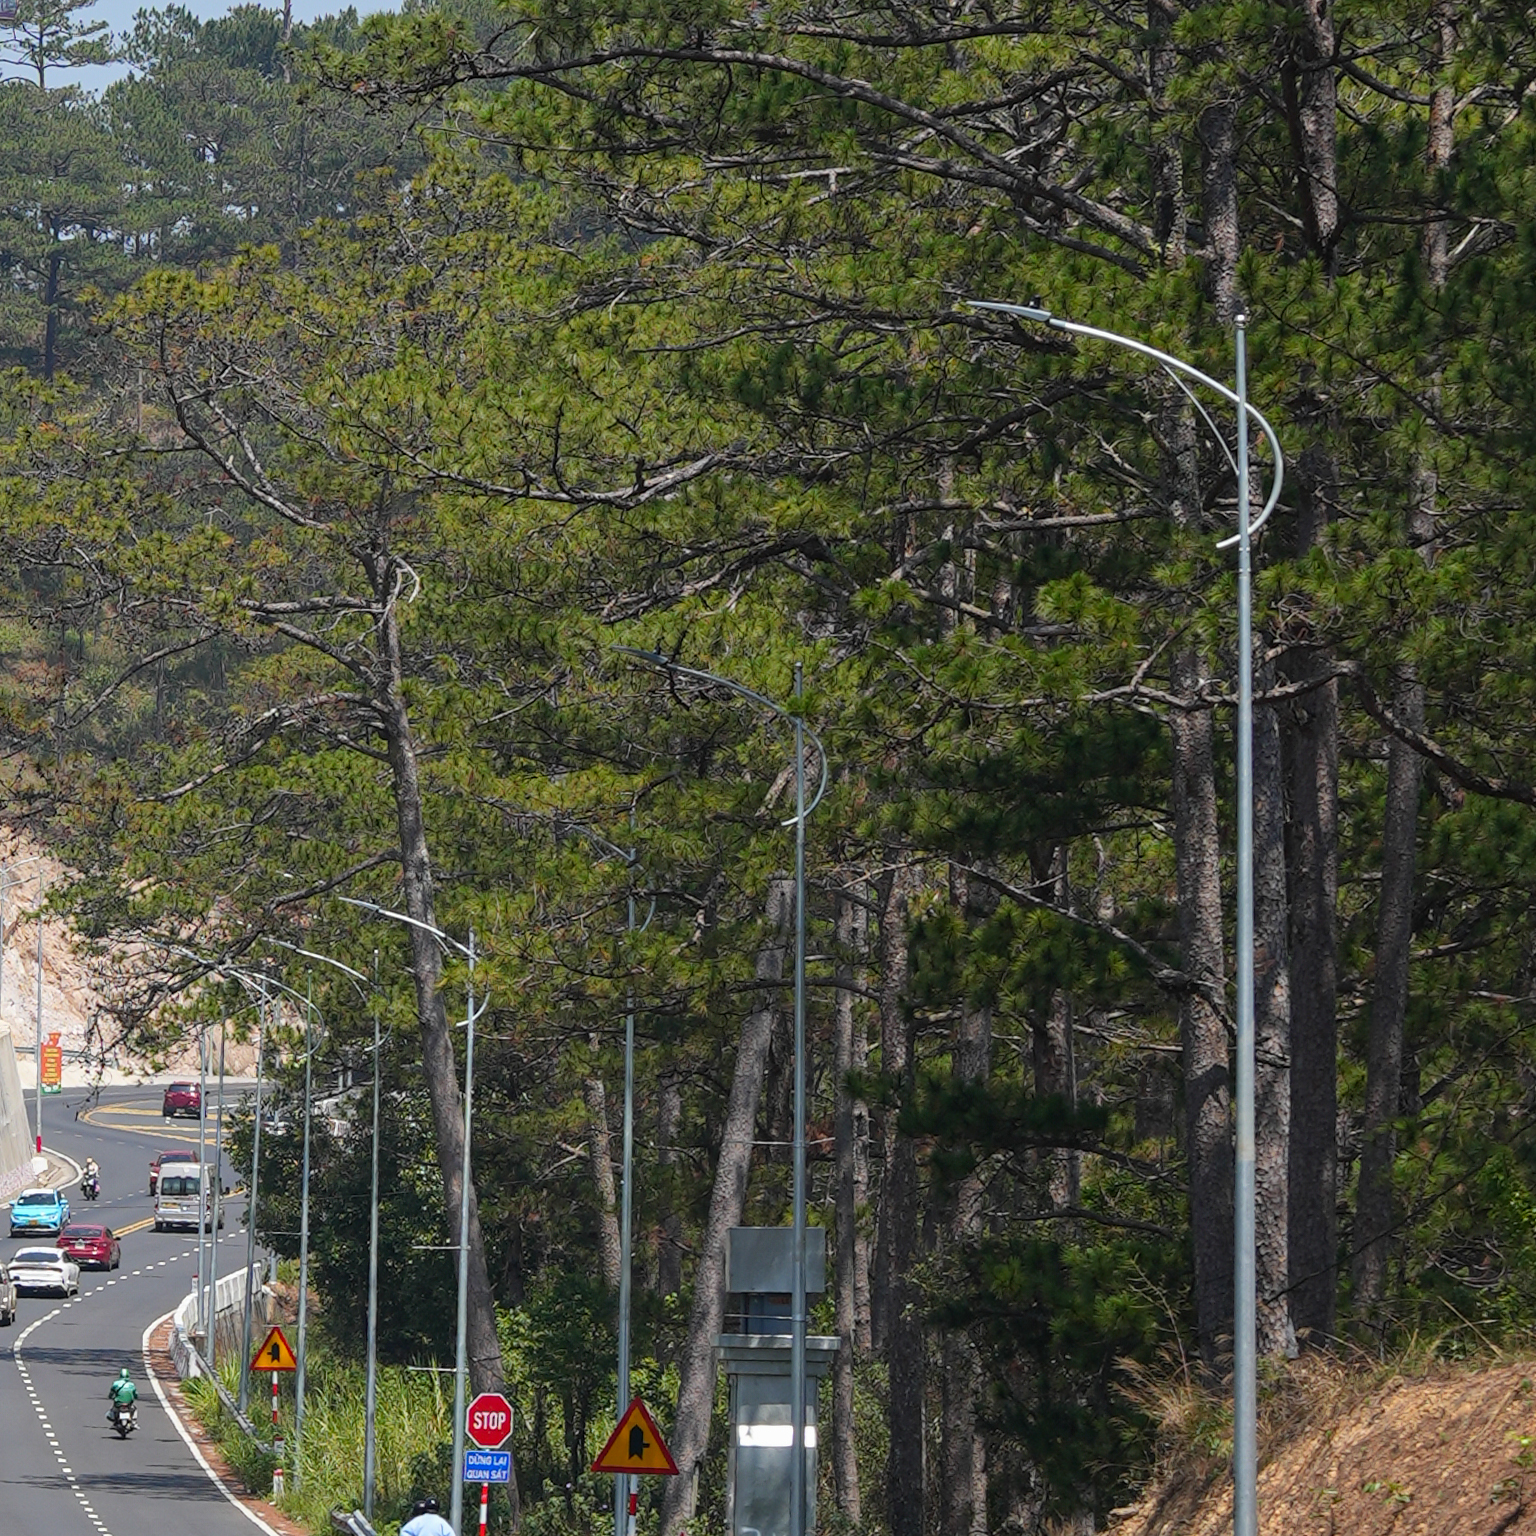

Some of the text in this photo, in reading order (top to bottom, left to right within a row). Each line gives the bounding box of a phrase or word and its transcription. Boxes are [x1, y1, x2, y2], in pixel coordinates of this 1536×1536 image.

[473, 1411, 506, 1431] STOP
[468, 1453, 492, 1465] DỪNG
[467, 1467, 507, 1479] QUAN SÁT
